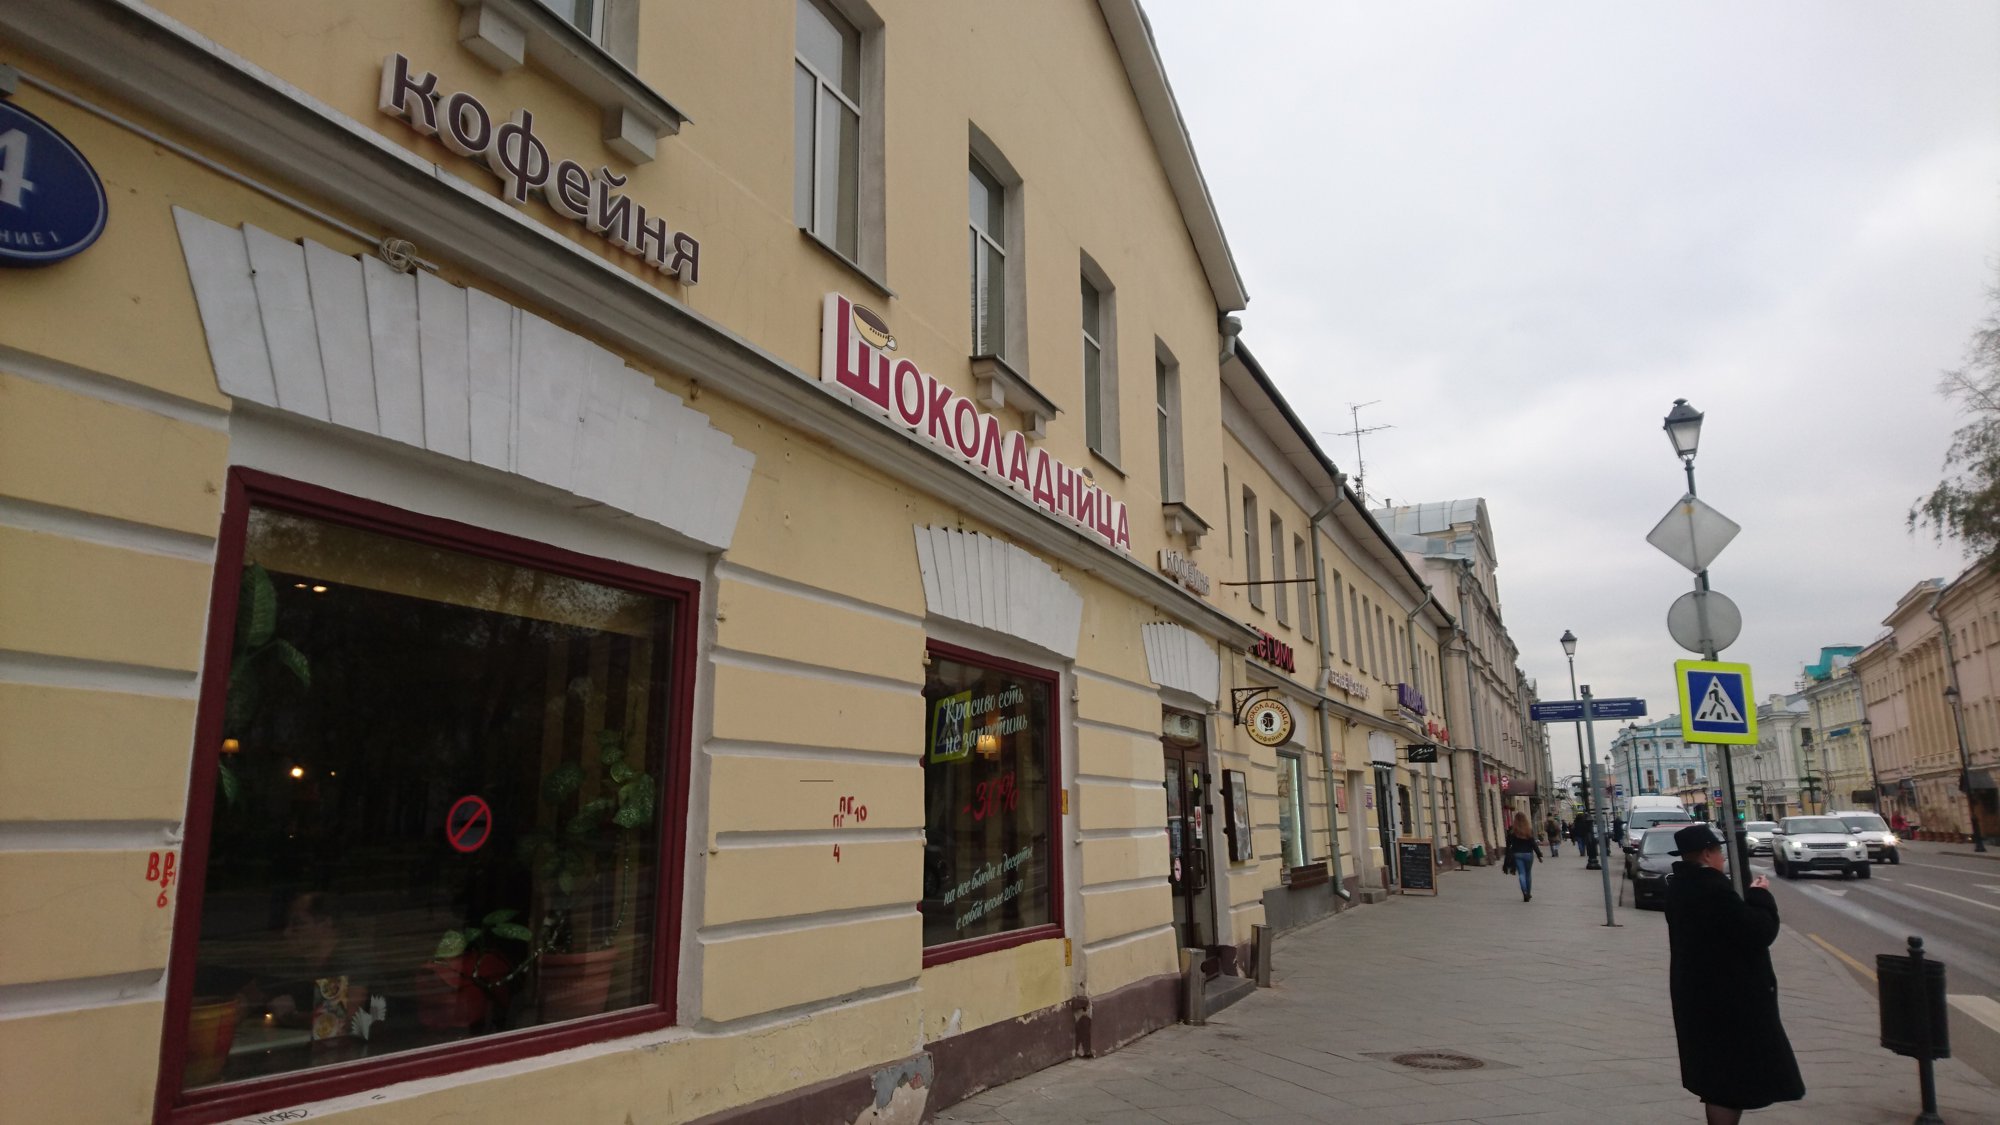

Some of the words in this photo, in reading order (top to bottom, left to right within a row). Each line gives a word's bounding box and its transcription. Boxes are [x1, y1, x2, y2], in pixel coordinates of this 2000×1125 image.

[836, 293, 1131, 550] ШОКОЛАДНИЦА
[943, 694, 996, 730] Красиво
[998, 684, 1024, 709] есть
[1248, 702, 1289, 727] ШОКОЛАДНИЦА
[945, 733, 961, 755] не
[833, 844, 840, 863] 4
[157, 890, 168, 909] 6
